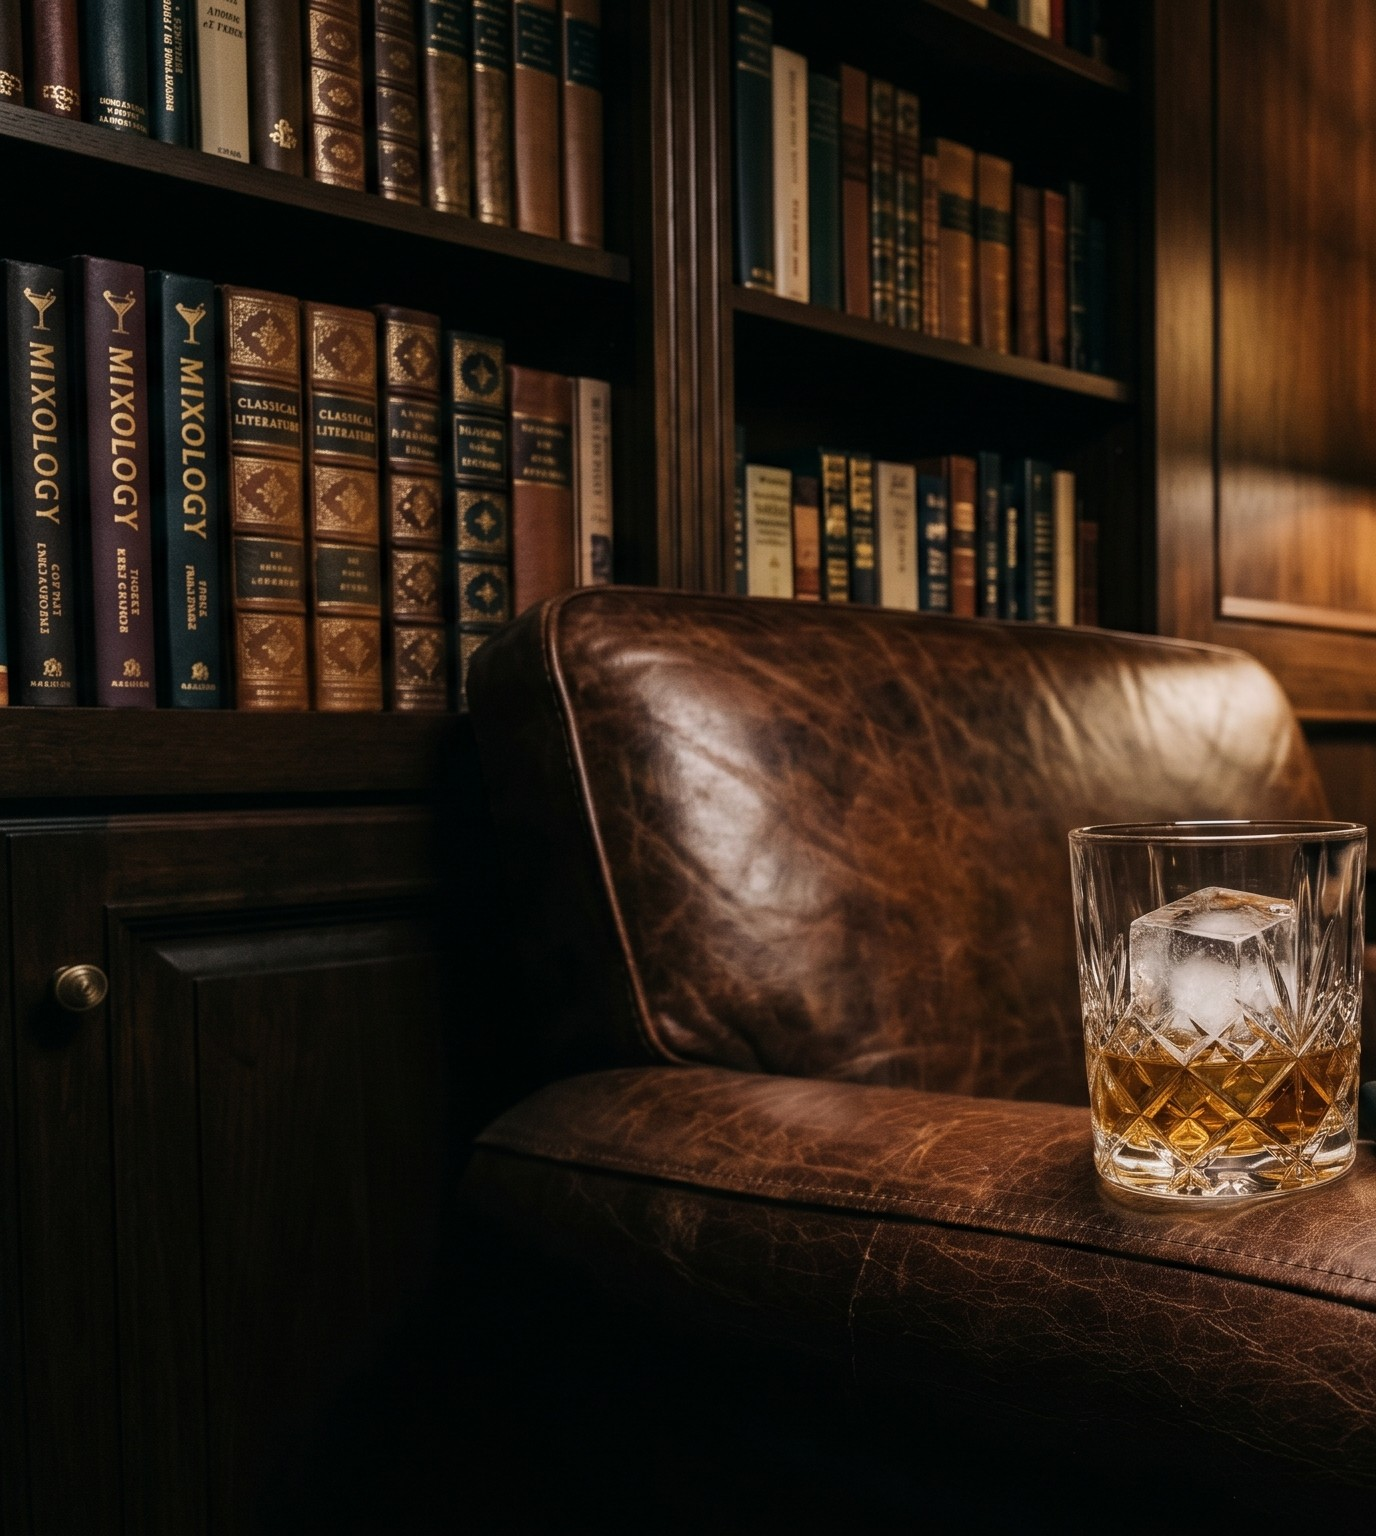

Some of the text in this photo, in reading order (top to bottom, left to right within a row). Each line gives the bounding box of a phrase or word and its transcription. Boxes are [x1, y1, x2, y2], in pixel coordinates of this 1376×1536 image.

[29, 341, 60, 525] MIXOLOGY
[109, 346, 139, 531] MIXOLOGY
[179, 357, 207, 540] MIXOLOGY
[237, 397, 297, 416] CLASSICAL
[318, 409, 374, 426] CLASSICAL
